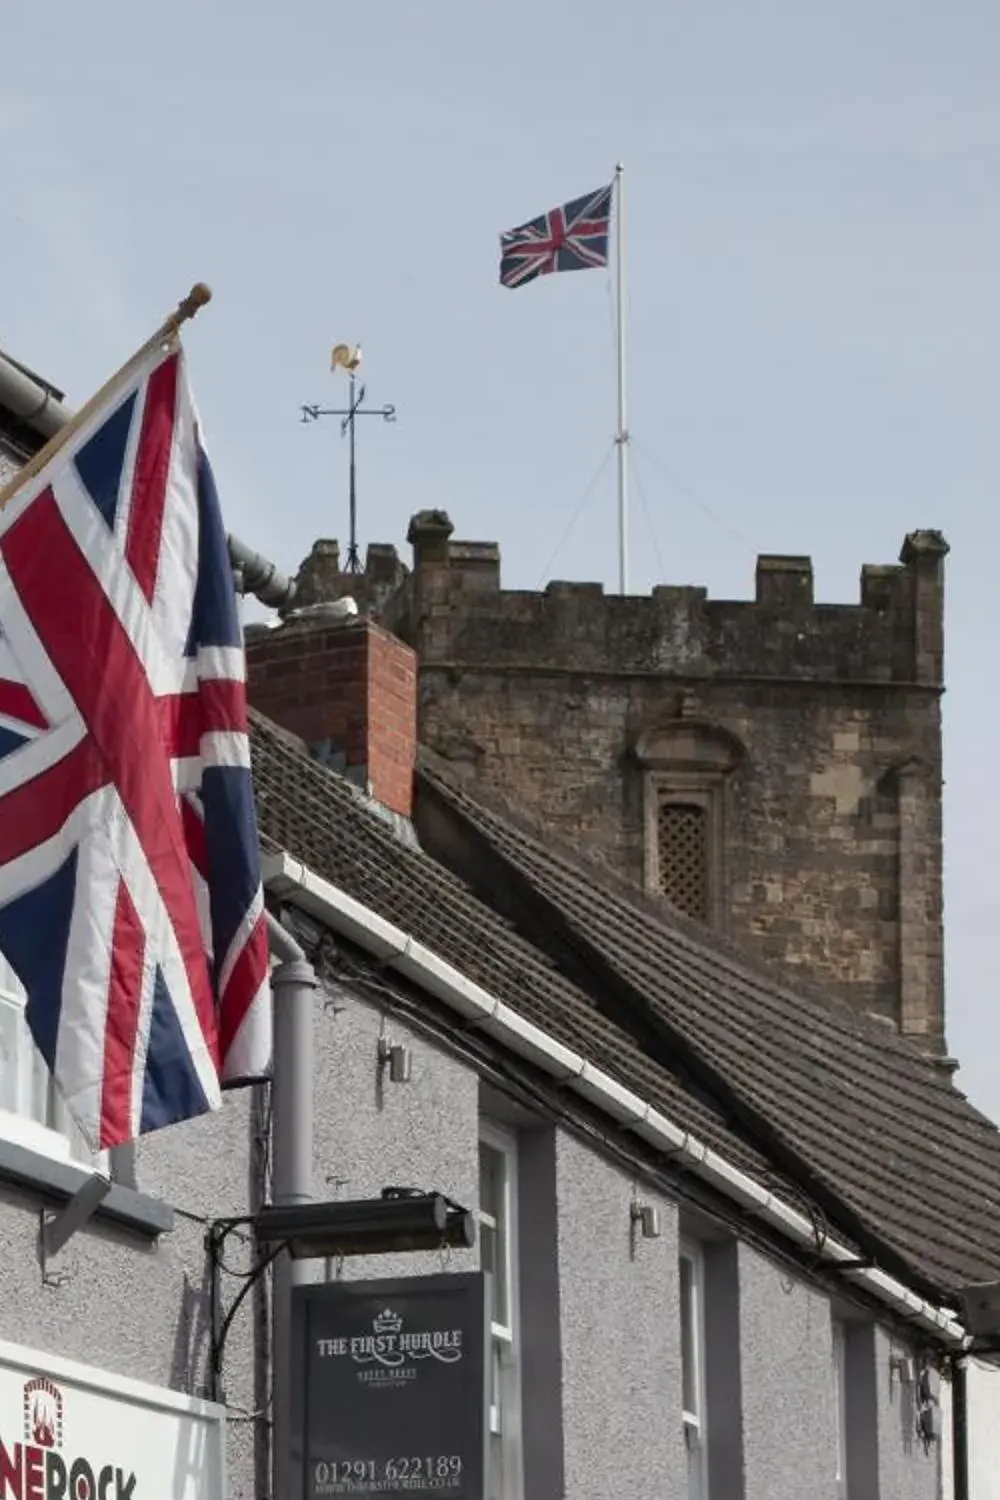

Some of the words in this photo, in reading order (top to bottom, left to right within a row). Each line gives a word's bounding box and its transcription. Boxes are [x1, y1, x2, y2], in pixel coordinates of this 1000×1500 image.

[317, 1337, 347, 1357] THE
[351, 1335, 405, 1366] FIRST
[400, 1330, 463, 1363] HURDLE
[315, 1459, 376, 1484] 01291
[384, 1455, 462, 1481] 622189
